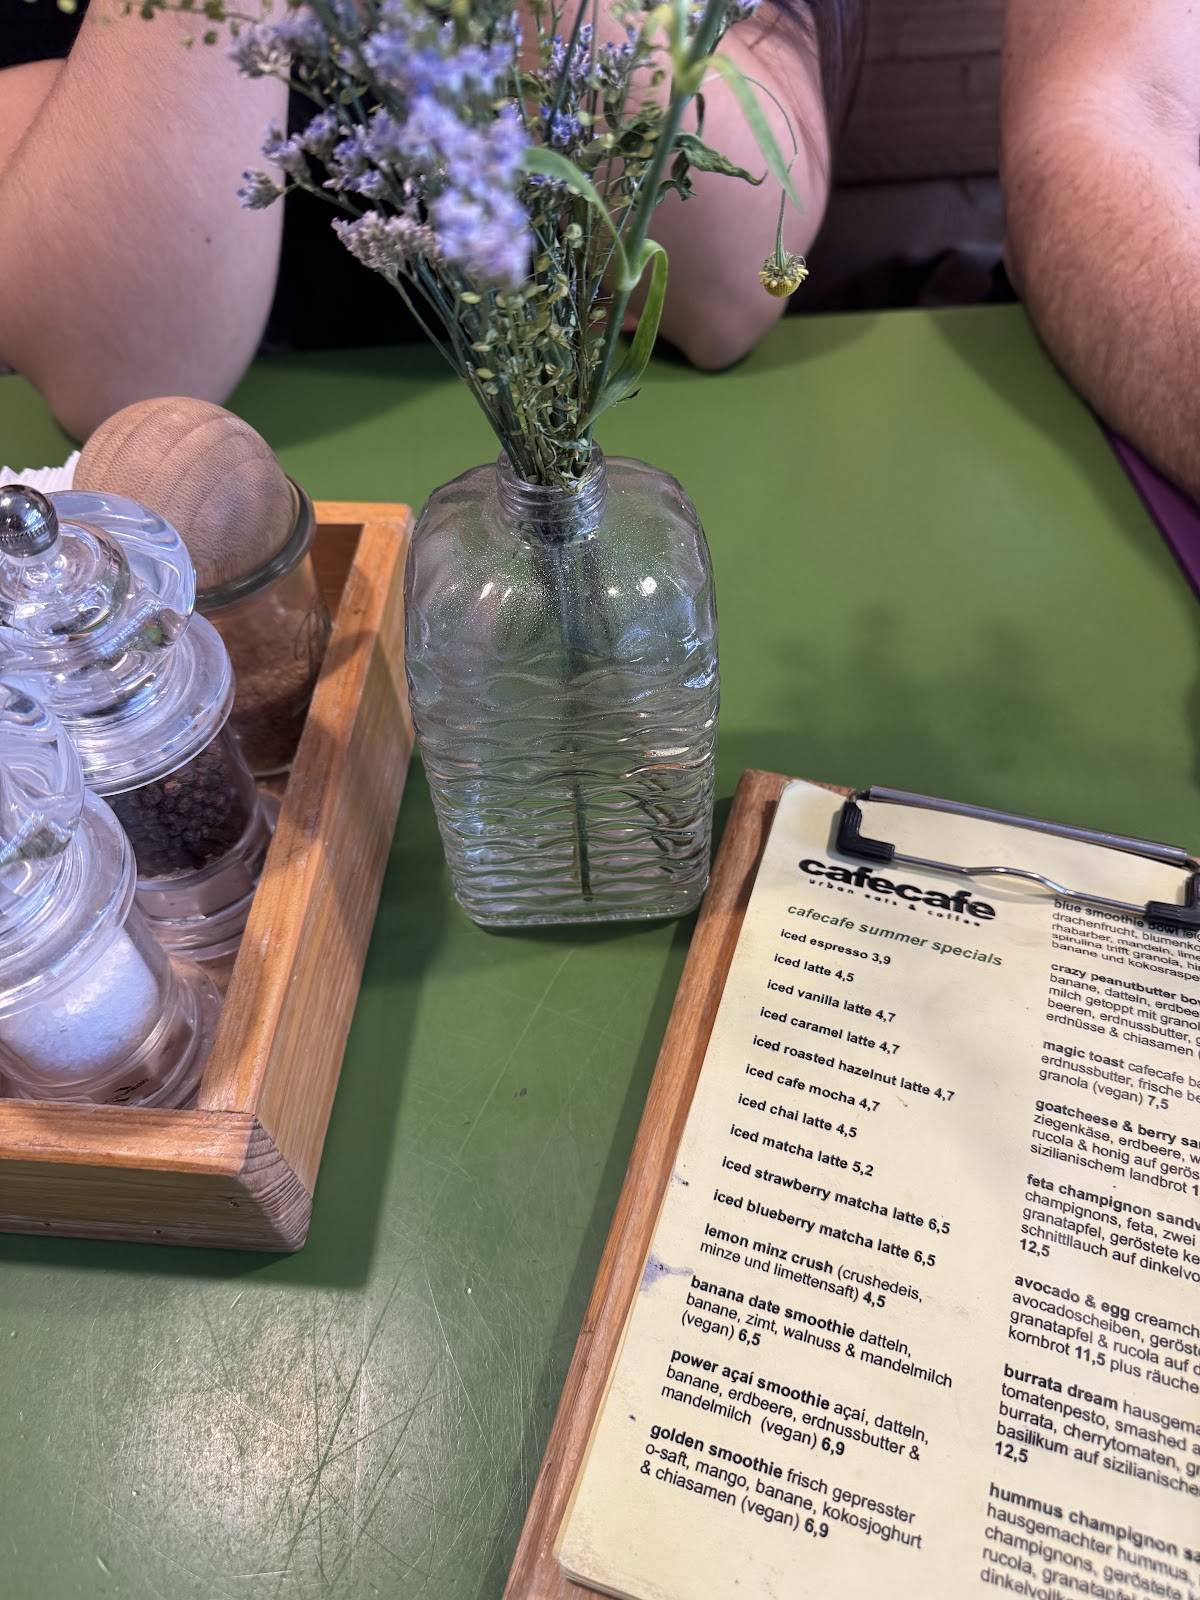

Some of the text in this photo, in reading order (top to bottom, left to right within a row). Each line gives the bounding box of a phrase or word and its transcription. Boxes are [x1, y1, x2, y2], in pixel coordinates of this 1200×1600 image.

[799, 859, 996, 920] cafecafe
[809, 879, 854, 895] urban
[788, 906, 1003, 966] cafecafe summer specials
[1052, 912, 1138, 939] drachenfrucht,
[1054, 899, 1144, 928] blue smoothie
[780, 929, 891, 965] iced espresso 3,9
[1052, 923, 1174, 957] rhabarber, mandeln,
[1052, 933, 1183, 968] spirulina granola,
[1052, 940, 1125, 965] banane und
[774, 953, 855, 982] iced latte 4,5
[1050, 964, 1178, 1000] crazy peanutbutter
[1050, 973, 1152, 1007] banane, datteln,
[767, 979, 896, 1023] iced vanilla latte 4,7
[1048, 997, 1192, 1044] beeren, erdnussbutter,
[1049, 987, 1135, 1015] milch getoppt
[760, 1006, 901, 1055] iced caramel latte 4,7
[1046, 1013, 1194, 1057] erdnüsse chiasamen
[753, 1034, 955, 1101] iced roasted hazelnut latte 4,7
[1041, 1055, 1184, 1098] erdnussbutter, frische
[1043, 1041, 1185, 1084] magic toast cafecafe
[745, 1063, 880, 1112] iced cafe mocha 4,7
[1039, 1069, 1169, 1110] granola (vegan) 7,5
[738, 1093, 857, 1138] iced chai latte 4,5
[1033, 1114, 1185, 1163] ziegenkäse, erdbeere,
[1035, 1100, 1177, 1146] goatcheese berry
[730, 1124, 874, 1177] iced matcha latte 5,2
[1030, 1143, 1188, 1194] sizilianischem landbrot
[1032, 1129, 1130, 1165] rucola honig
[721, 1155, 951, 1235] iced strawberry matcha latte 6,5
[1025, 1190, 1196, 1247] champignons, feta, zwei
[1027, 1173, 1152, 1218] feta champignon
[713, 1188, 936, 1267] iced blueberry matcha latte 6,5
[1020, 1238, 1050, 1257] 12,5
[1022, 1208, 1179, 1260] granatapfel, geröstete
[700, 1242, 887, 1308] minze und limettensaft) 4,5
[704, 1223, 922, 1303] lemon minz crush (crushedeis,
[691, 1275, 911, 1359] banana date smoothie datteln,
[1012, 1293, 1144, 1344] avocadoscheiben,
[1014, 1276, 1130, 1321] avocado egg
[681, 1309, 762, 1346] (vegan) 6,5
[686, 1291, 952, 1388] banane, zimt, walnuss & mandelmilch
[1010, 1311, 1159, 1365] granatapfel rucola
[1008, 1325, 1141, 1378] kornbrot 11,5 plus
[670, 1349, 928, 1445] power açaí smoothie açaí, datteln,
[1001, 1382, 1109, 1430] tomatenpesto,
[1004, 1363, 1118, 1411] burrata dream
[661, 1385, 845, 1456] mandelmilch (vegan) 6,9
[666, 1364, 920, 1461] banane, erdbeere, erdnussbutter &
[999, 1400, 1057, 1434] burrata,
[995, 1441, 1029, 1463] 12,5
[996, 1420, 1069, 1456] basilikum
[645, 1443, 922, 1550] o-saft, mango, banane, kokosjoghurt
[650, 1425, 916, 1524] golden smoothie frisch gepresster
[640, 1459, 829, 1538] & chiasamen (vegan) 6,9
